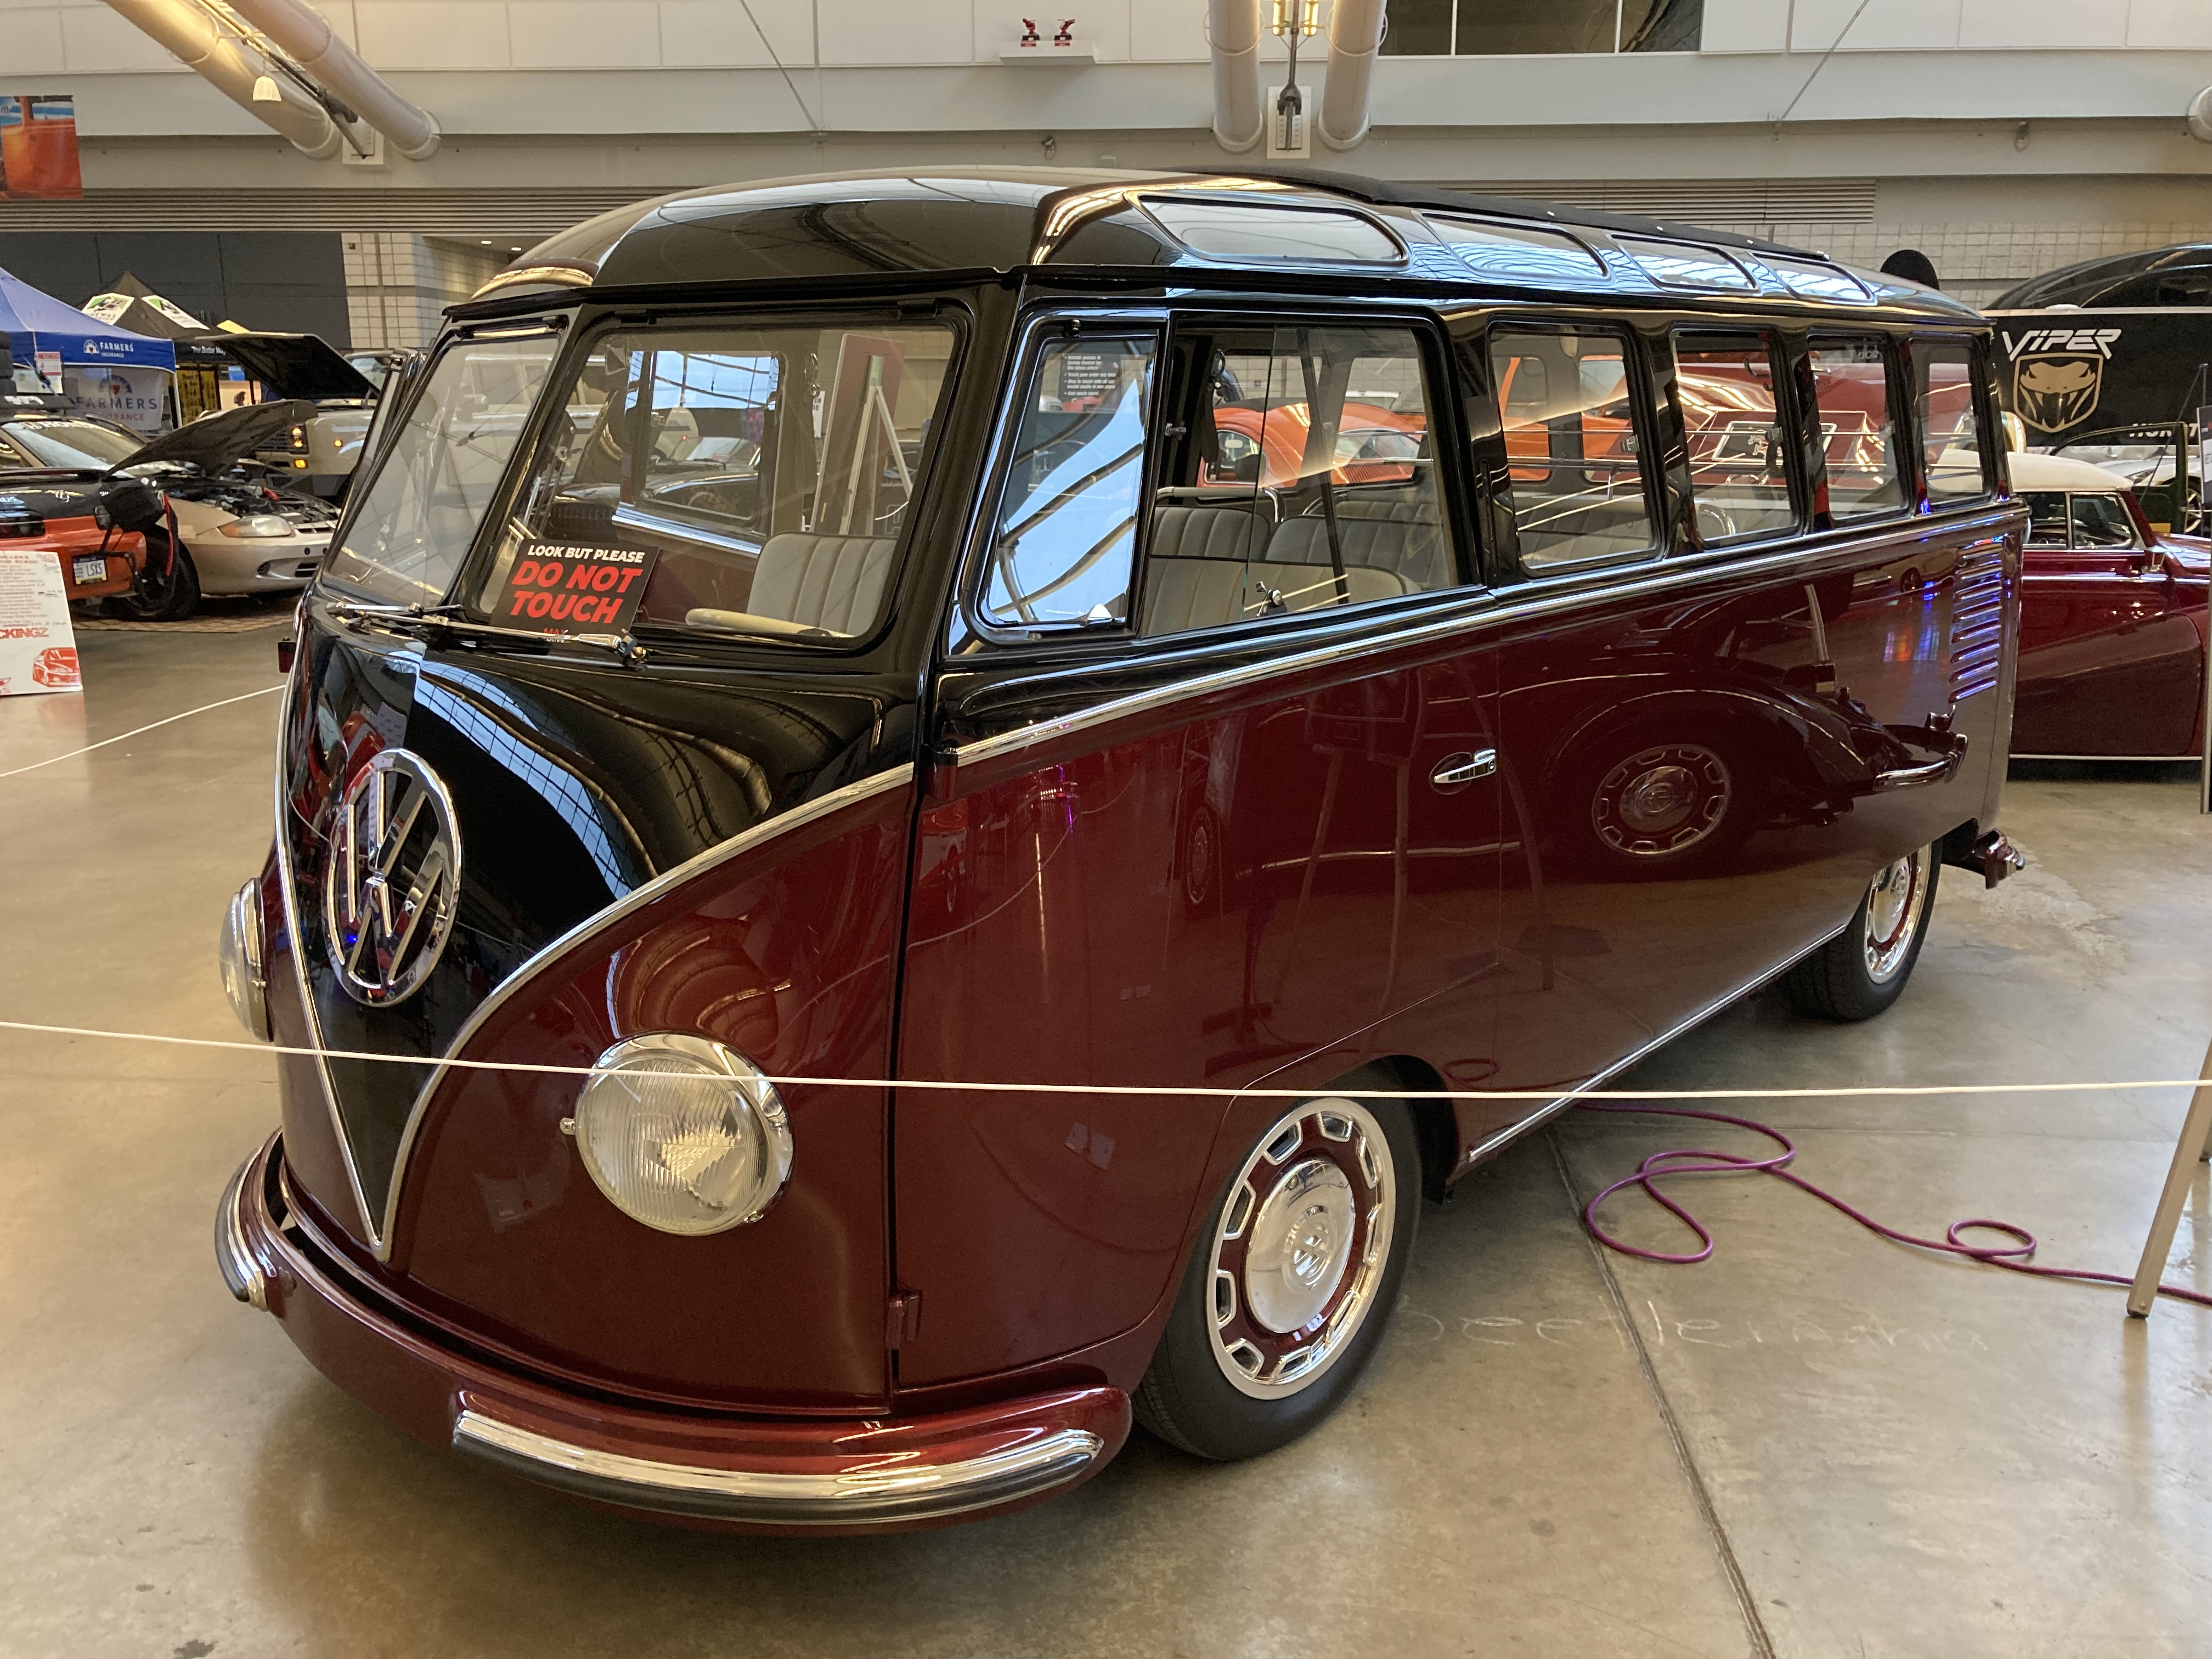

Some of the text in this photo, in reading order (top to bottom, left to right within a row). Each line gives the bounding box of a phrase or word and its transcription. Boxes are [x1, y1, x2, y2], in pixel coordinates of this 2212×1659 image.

[100, 342, 134, 352] FARMERS
[76, 397, 158, 409] FARMERS
[528, 544, 645, 563] LOOK BUT PLEASE
[511, 561, 644, 593] DO NOT
[510, 591, 623, 624] TOUCH
